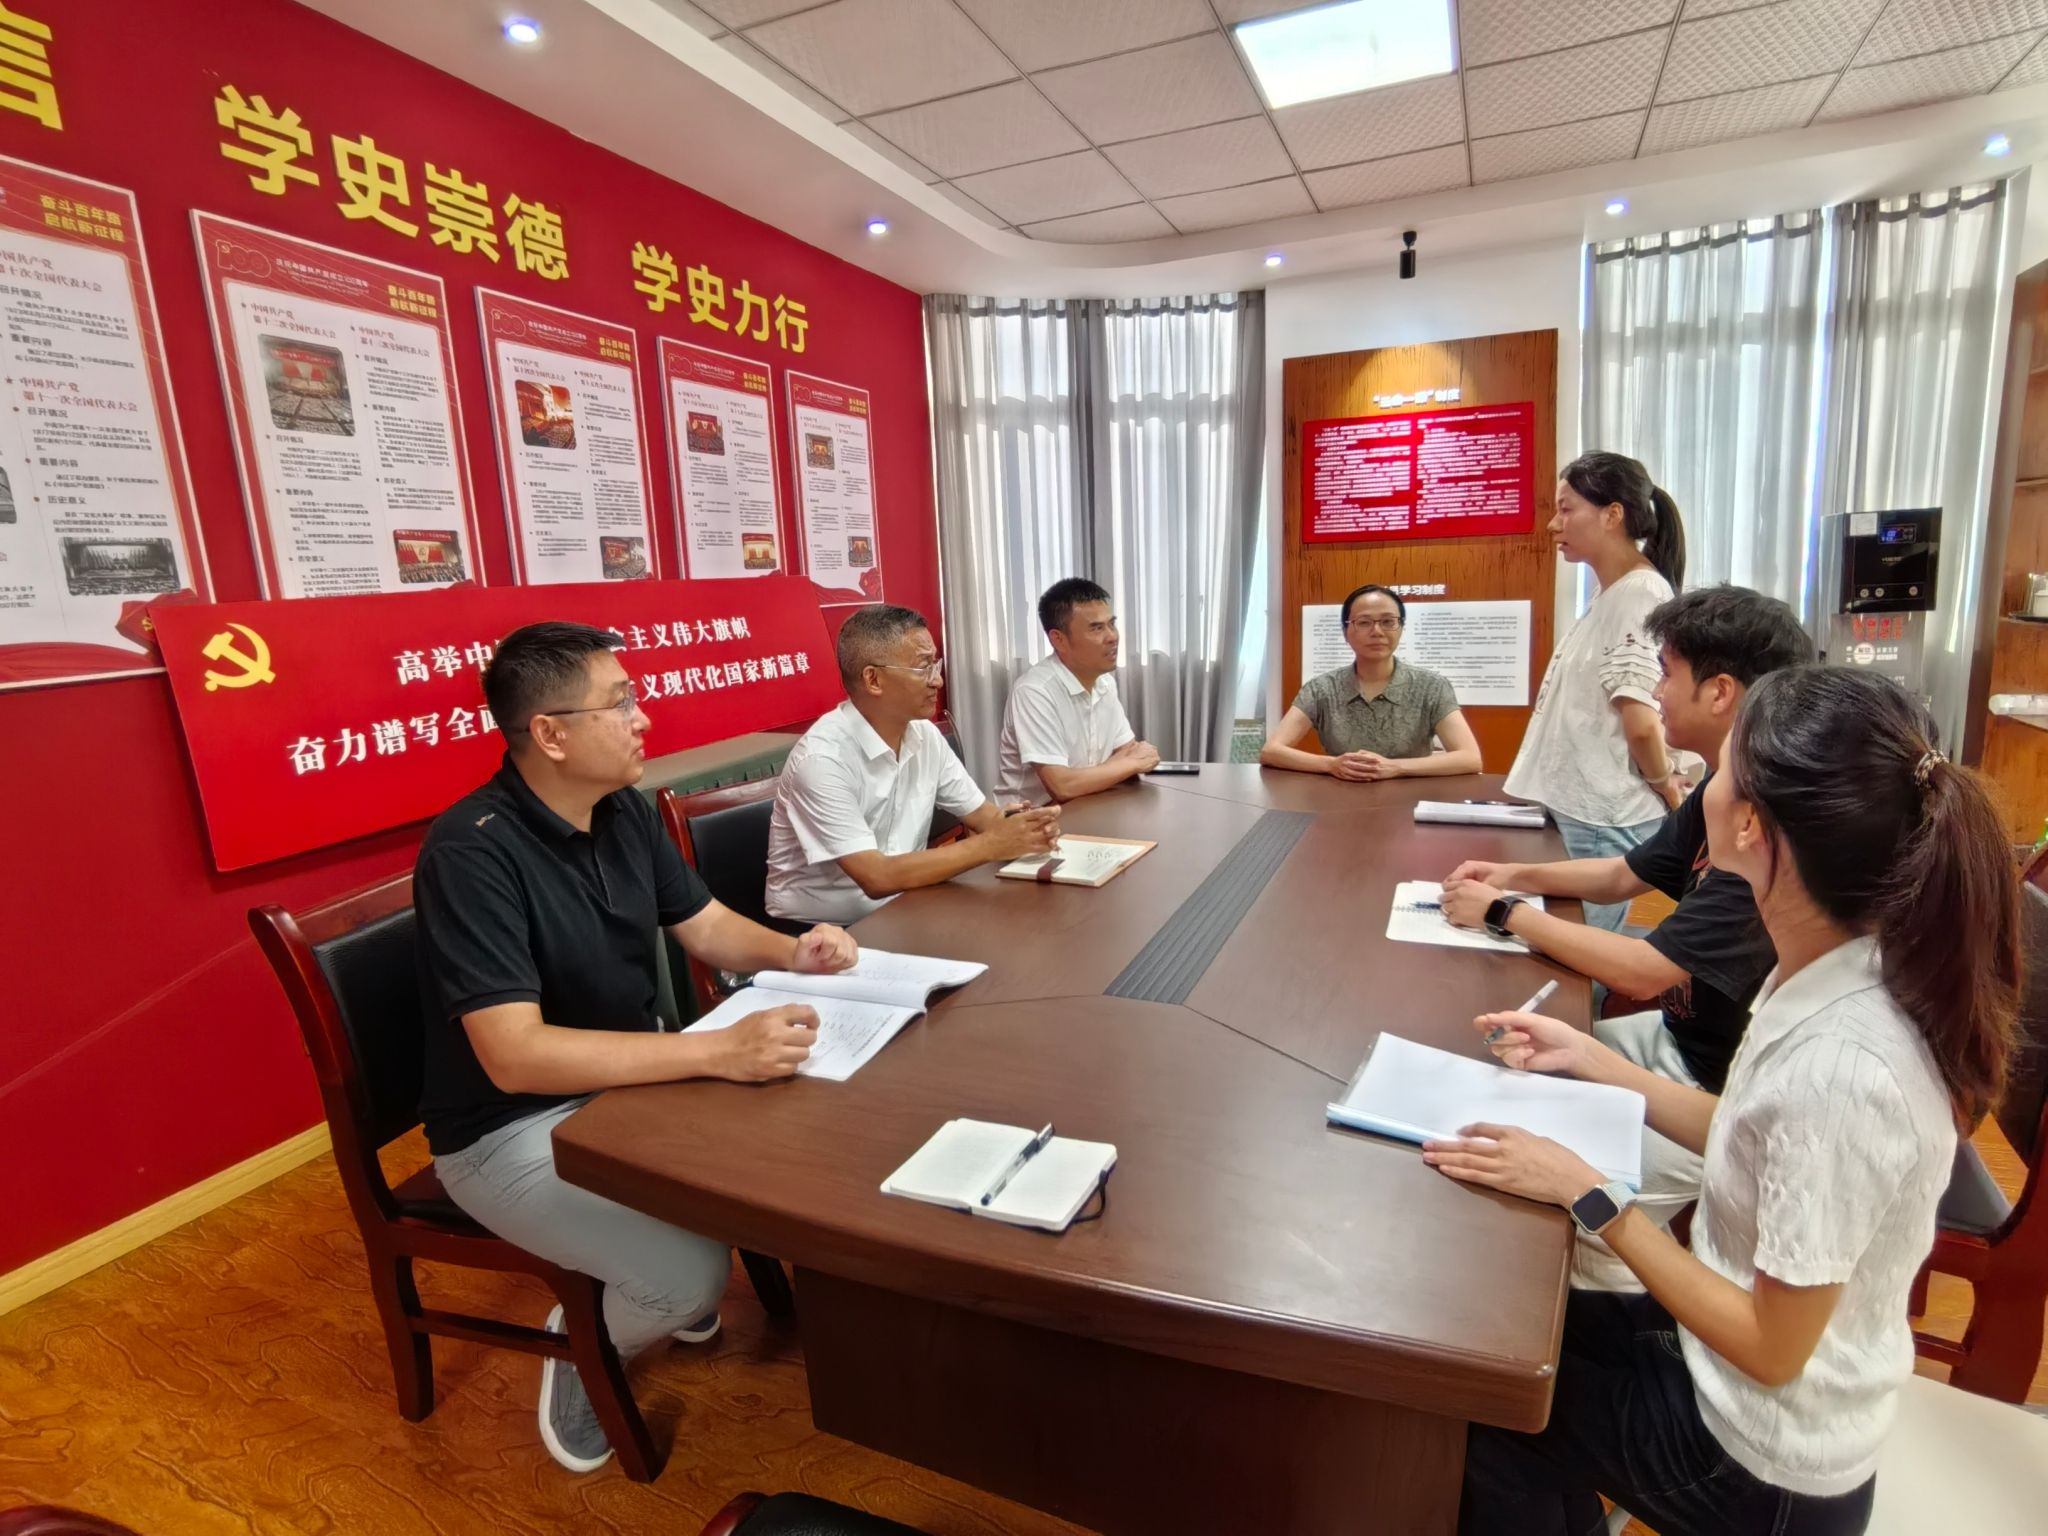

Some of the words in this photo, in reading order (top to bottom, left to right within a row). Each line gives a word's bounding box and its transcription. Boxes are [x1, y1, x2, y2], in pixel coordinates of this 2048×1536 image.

[215, 84, 569, 281] 学史崇德
[631, 241, 809, 353] 学史力行
